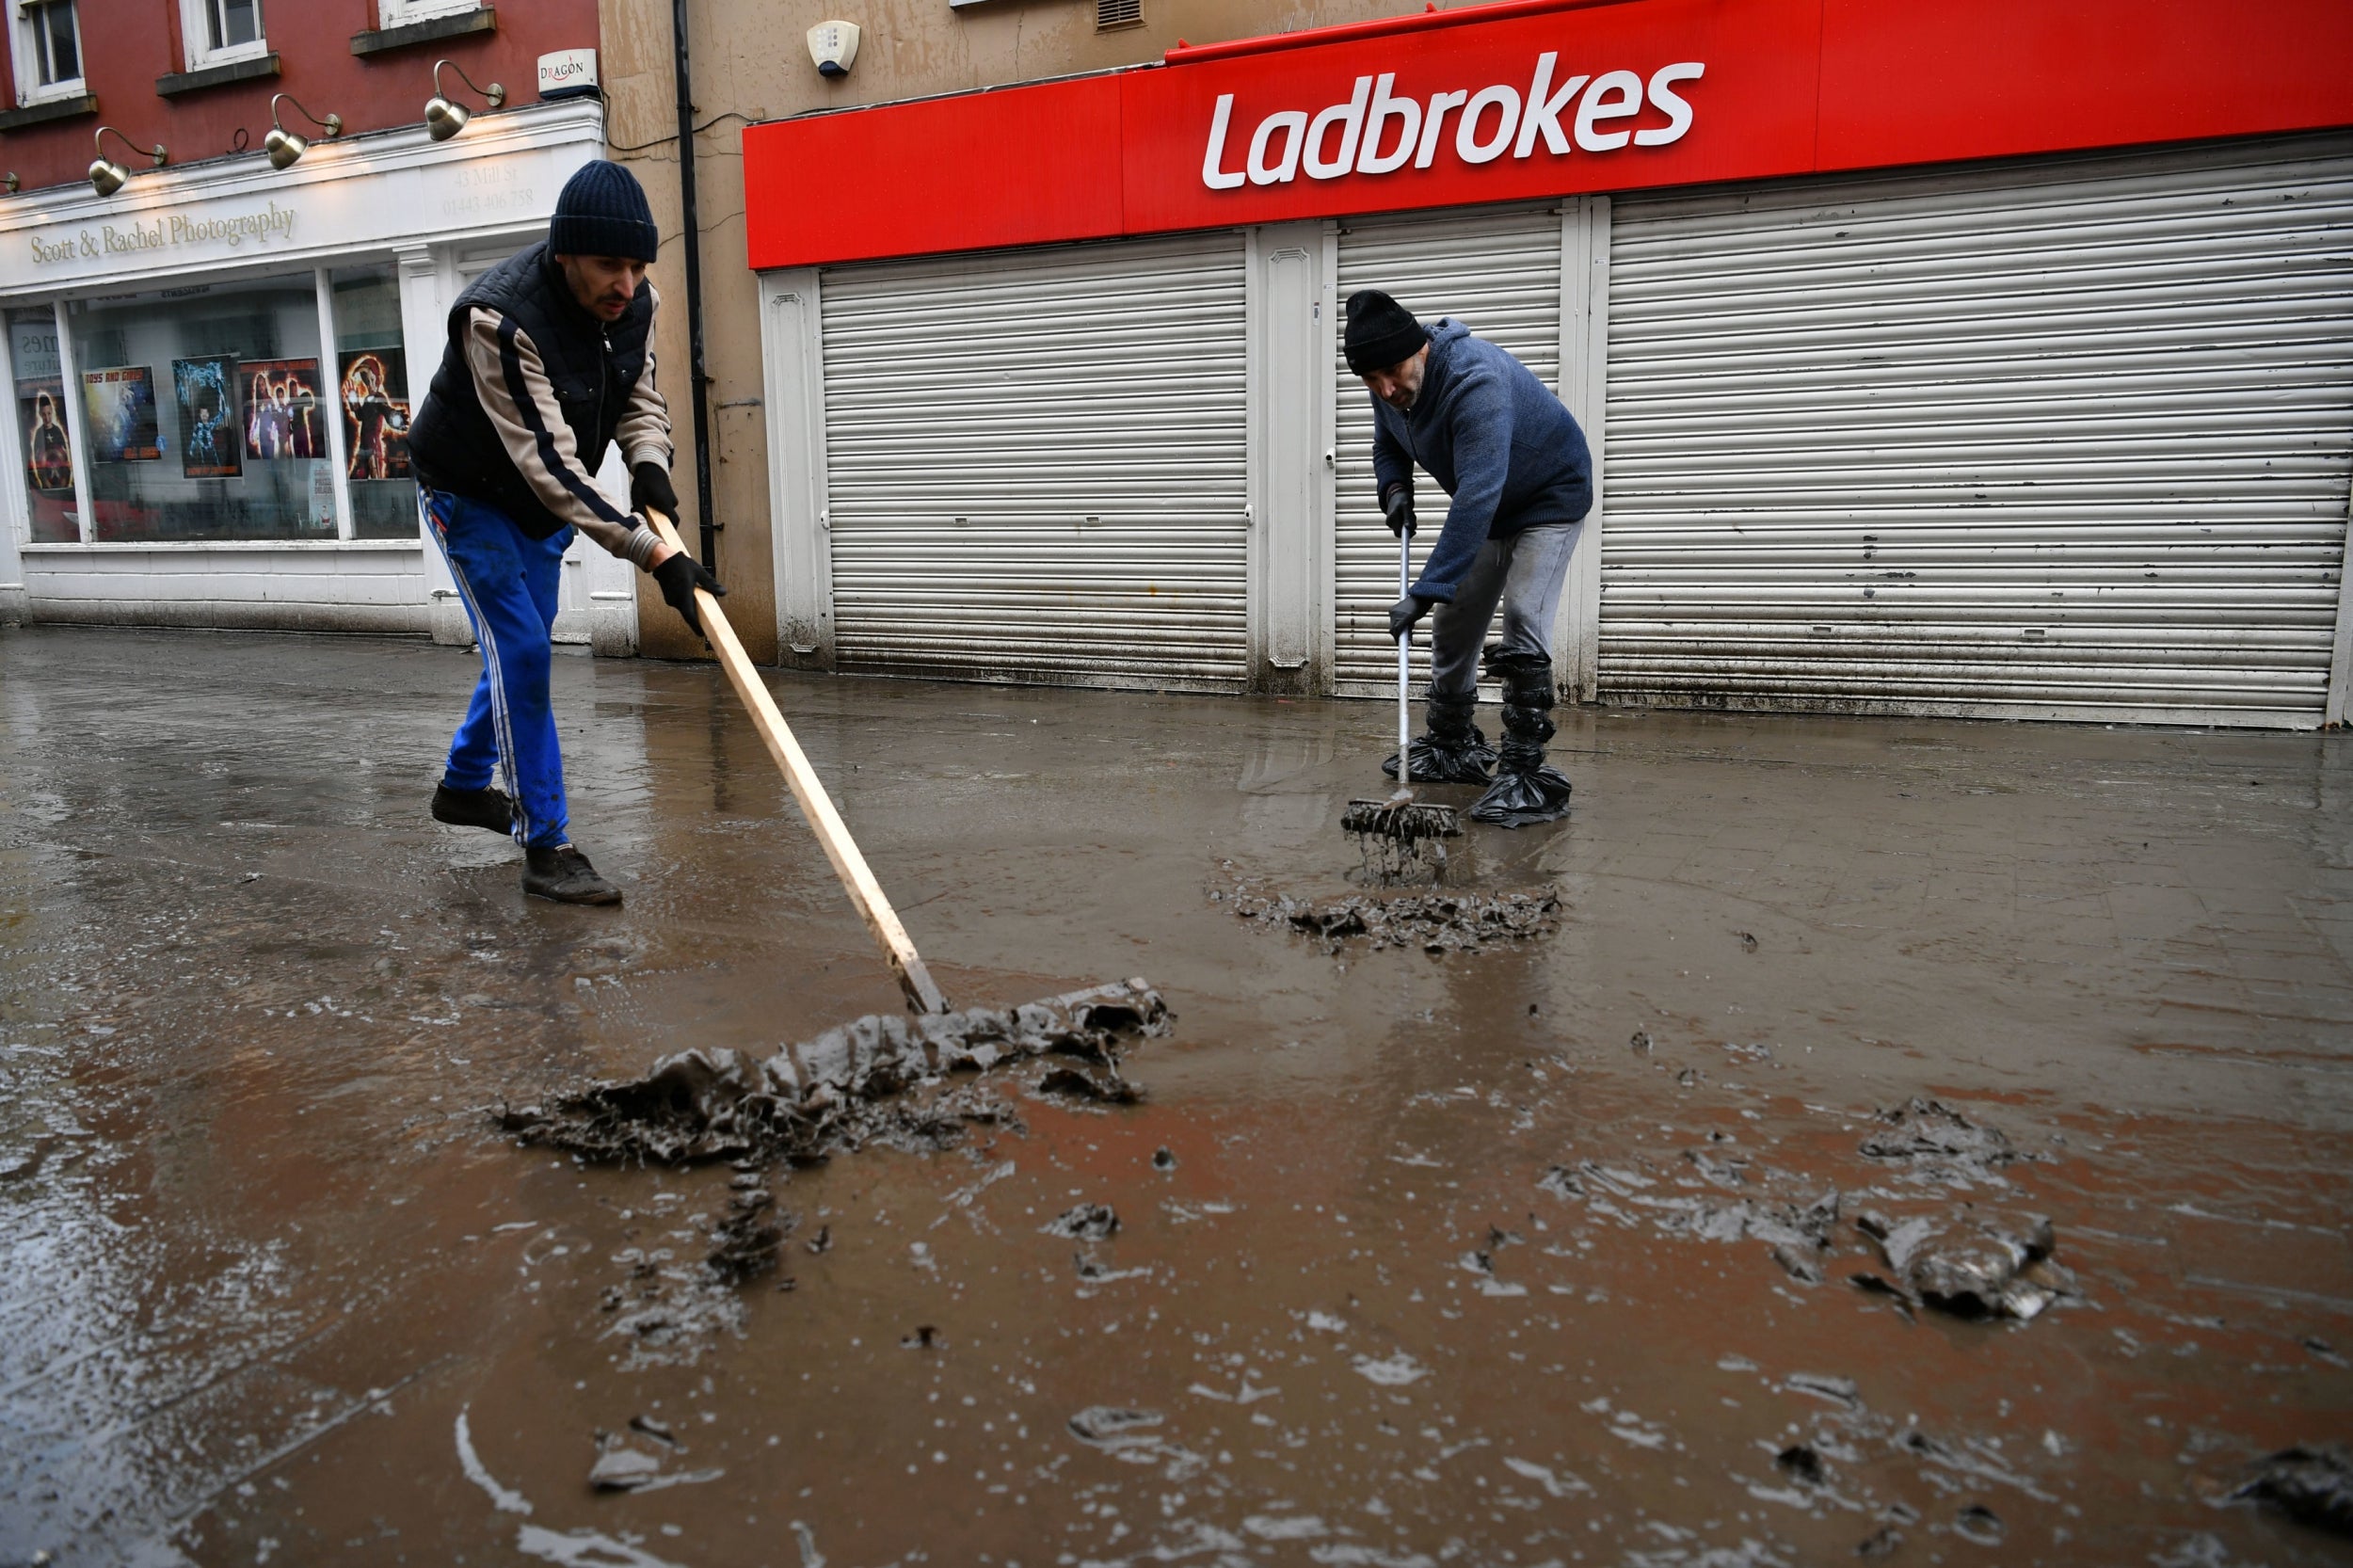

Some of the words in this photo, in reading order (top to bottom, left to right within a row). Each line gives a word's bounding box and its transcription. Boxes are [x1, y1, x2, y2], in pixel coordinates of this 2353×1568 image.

[540, 62, 584, 80] DRAGON
[1202, 51, 1705, 190] Ladbrokes
[454, 171, 470, 188] 43
[473, 166, 500, 185] Mill
[504, 166, 518, 181] St
[442, 195, 481, 216] 01443
[484, 192, 506, 210] 406
[510, 188, 535, 206] 758
[31, 235, 75, 264] Scott
[79, 229, 100, 258] &
[102, 217, 164, 254] Rachel
[168, 200, 295, 247] Photography
